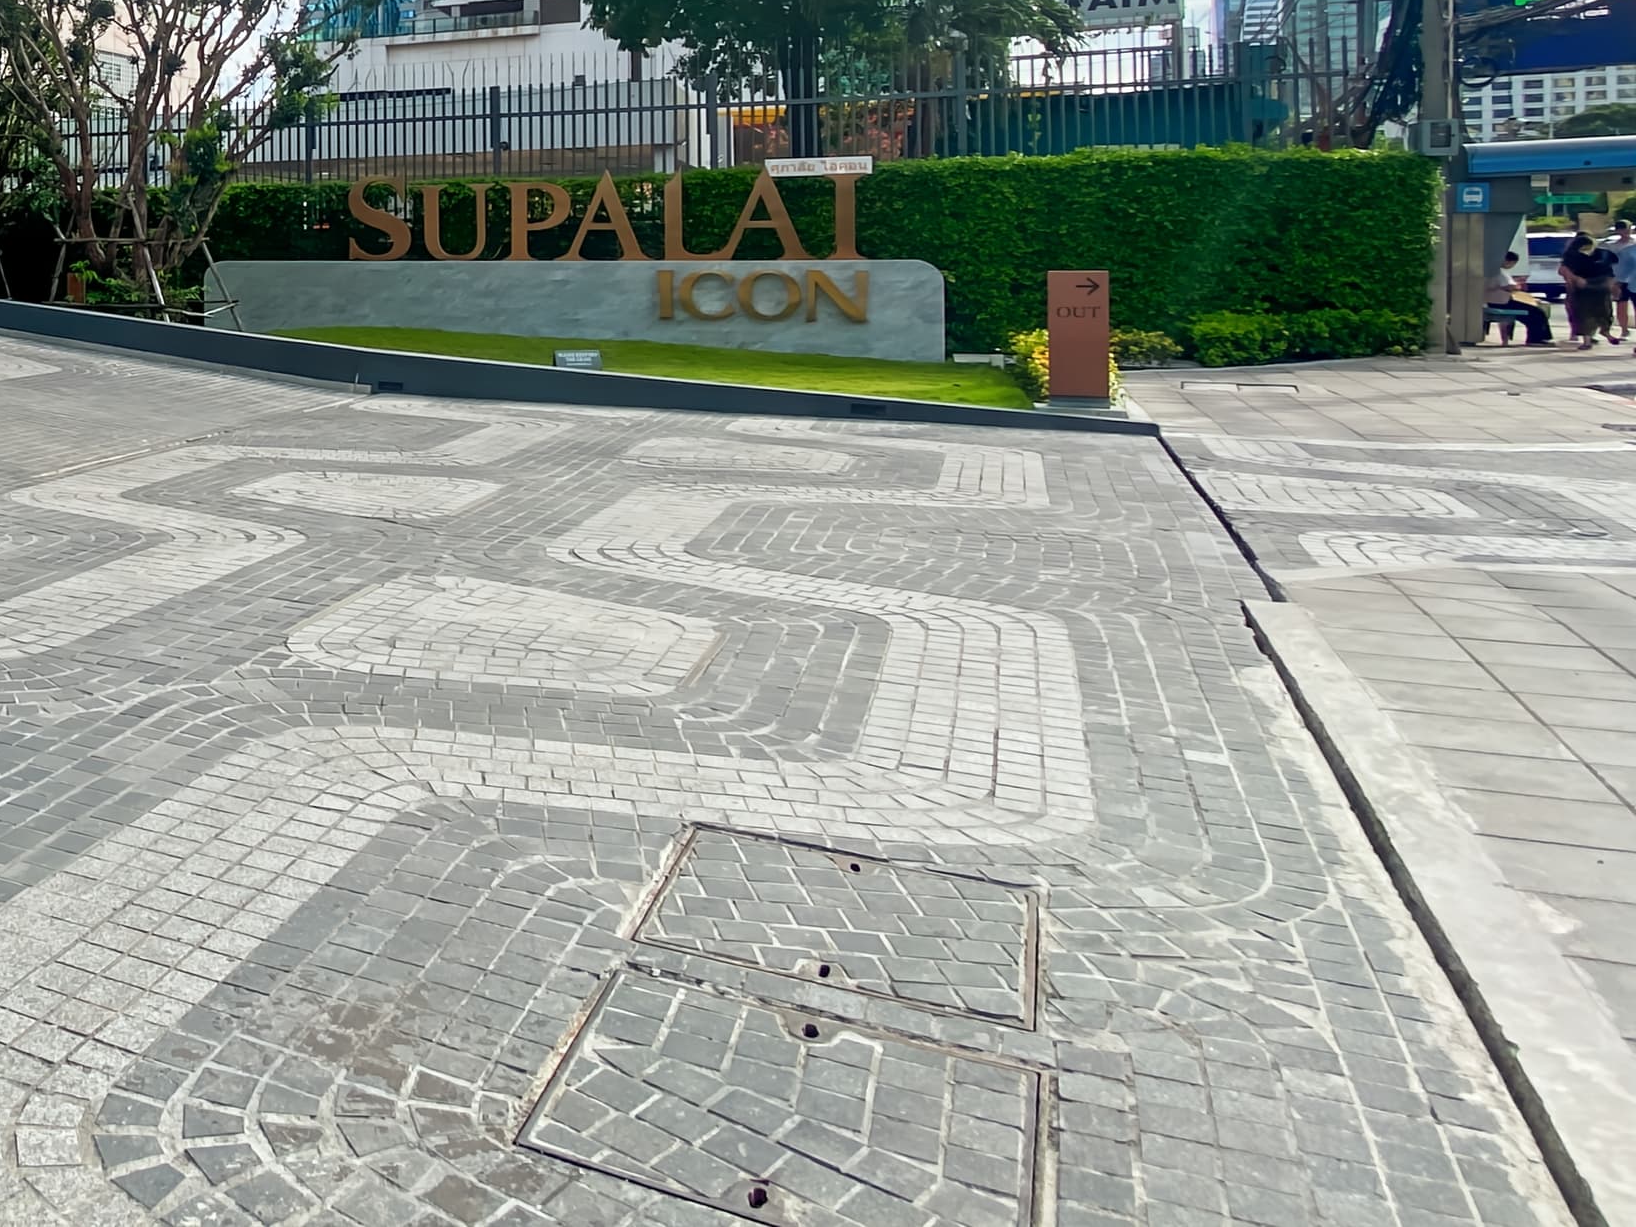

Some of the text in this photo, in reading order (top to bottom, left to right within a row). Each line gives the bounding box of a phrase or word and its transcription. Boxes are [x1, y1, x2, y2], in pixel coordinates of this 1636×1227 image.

[348, 168, 870, 261] SUPALAI
[656, 269, 870, 323] ICON
[1056, 305, 1101, 319] OUT
